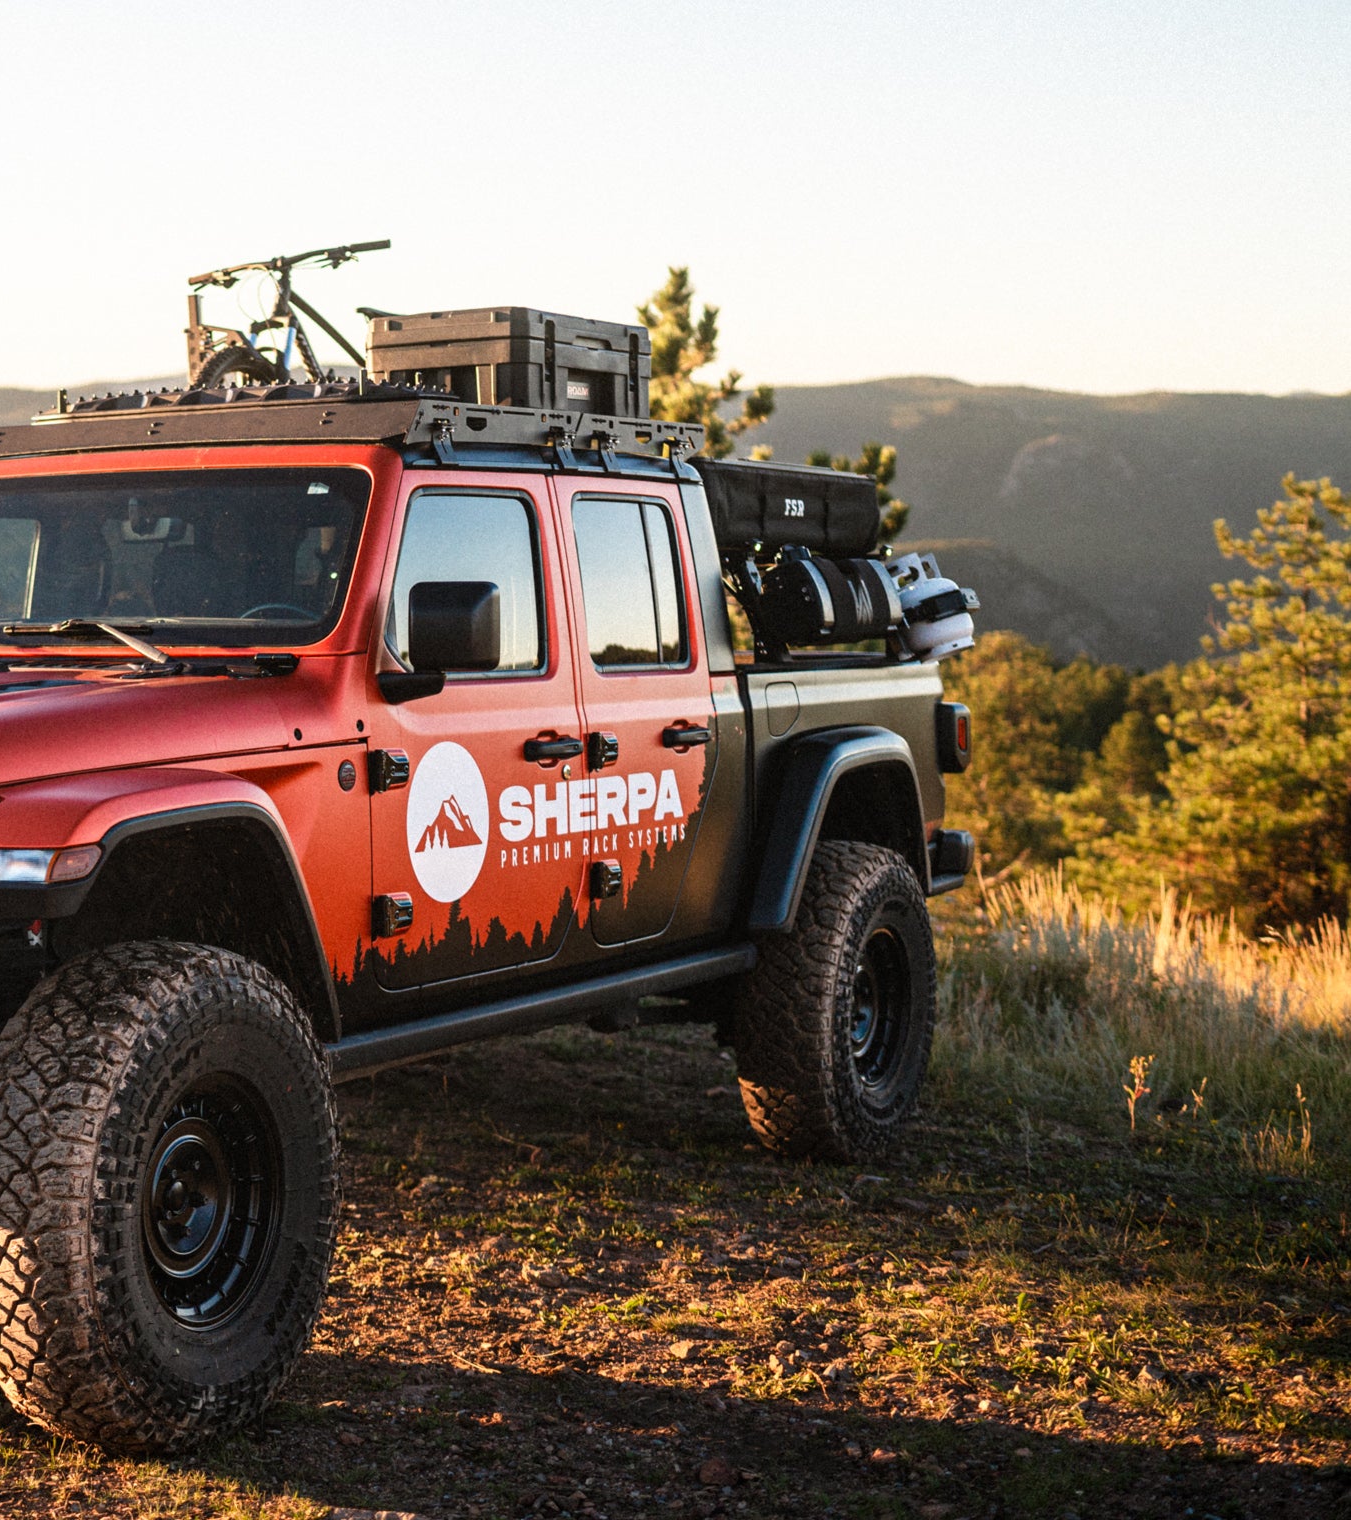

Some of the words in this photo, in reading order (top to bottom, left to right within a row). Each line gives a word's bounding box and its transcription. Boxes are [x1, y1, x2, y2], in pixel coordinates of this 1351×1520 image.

[567, 385, 589, 397] ROAM
[784, 498, 805, 517] FSR
[499, 769, 684, 842] SHERPA
[501, 841, 572, 868] PREMIUM
[582, 834, 618, 856] RACK
[628, 823, 686, 848] SYSTEMS
